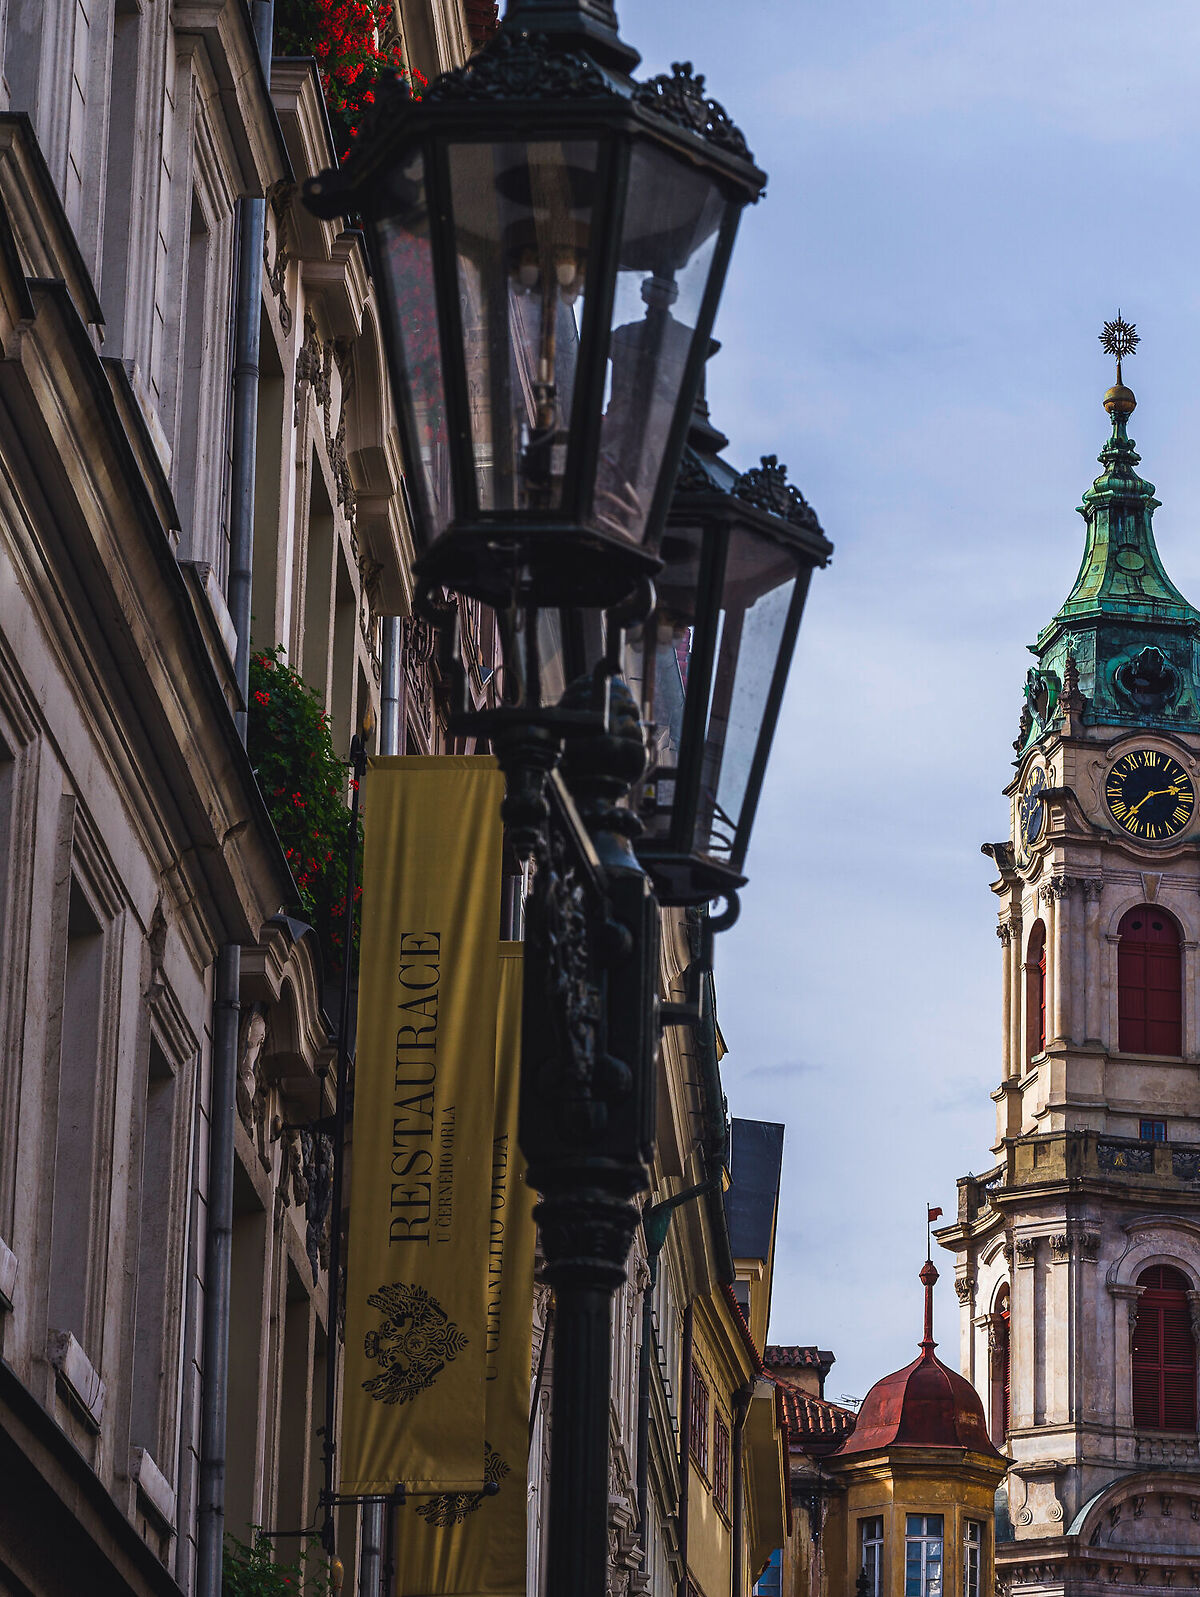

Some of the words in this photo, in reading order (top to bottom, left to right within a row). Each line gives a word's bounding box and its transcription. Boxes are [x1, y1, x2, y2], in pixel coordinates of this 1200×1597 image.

[1124, 754, 1139, 771] XI
[1143, 752, 1156, 767] XII
[1163, 759, 1171, 771] I
[1111, 768, 1127, 781] X
[1174, 774, 1188, 784] II
[1107, 786, 1122, 796] IX
[1178, 793, 1193, 803] III
[1111, 802, 1127, 820] VIII
[1125, 816, 1139, 833] VII
[1146, 823, 1156, 838] VI
[1165, 821, 1175, 835] V
[389, 932, 441, 1247] RESTAURACE
[441, 1106, 456, 1149] ORLA
[434, 1153, 454, 1227] ČERNÉHO
[437, 1231, 451, 1242] U
